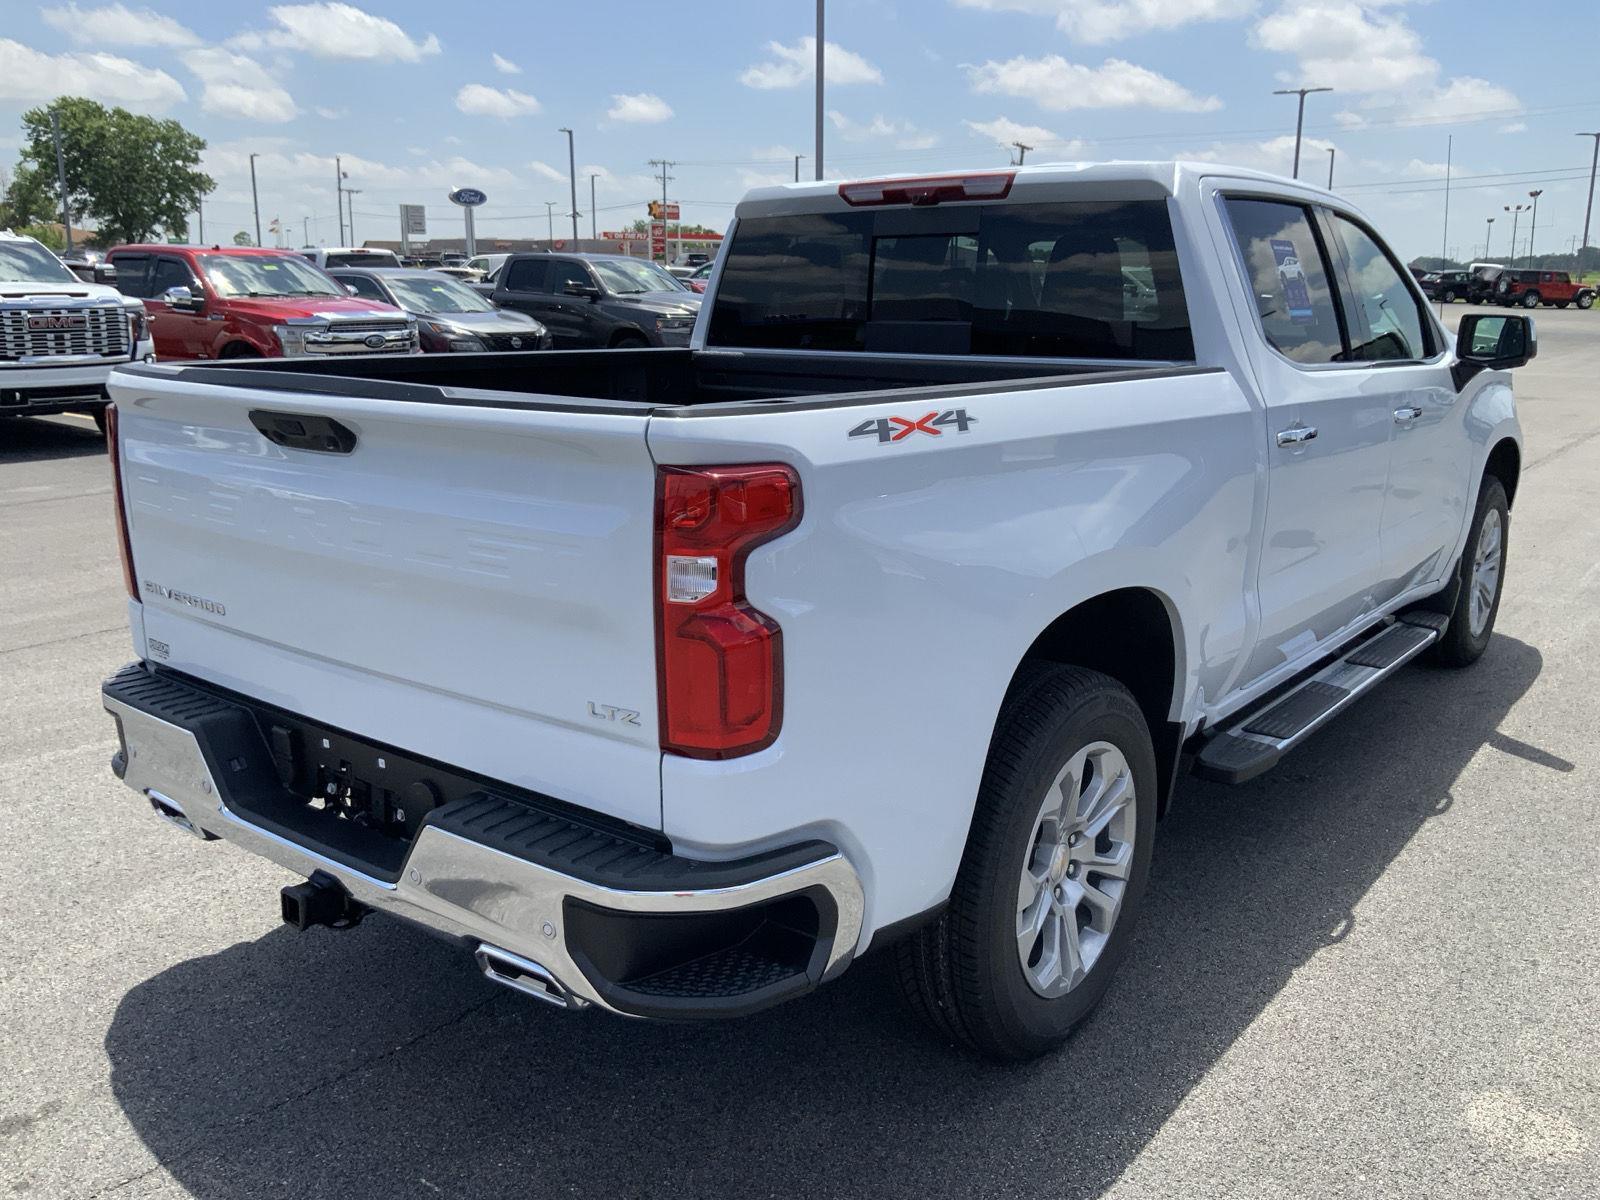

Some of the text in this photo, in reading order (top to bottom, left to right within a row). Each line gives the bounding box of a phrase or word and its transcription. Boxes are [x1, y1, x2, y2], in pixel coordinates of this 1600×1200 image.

[29, 316, 87, 330] GMC
[144, 581, 226, 617] SILVERADO
[587, 700, 642, 728] LTZ
